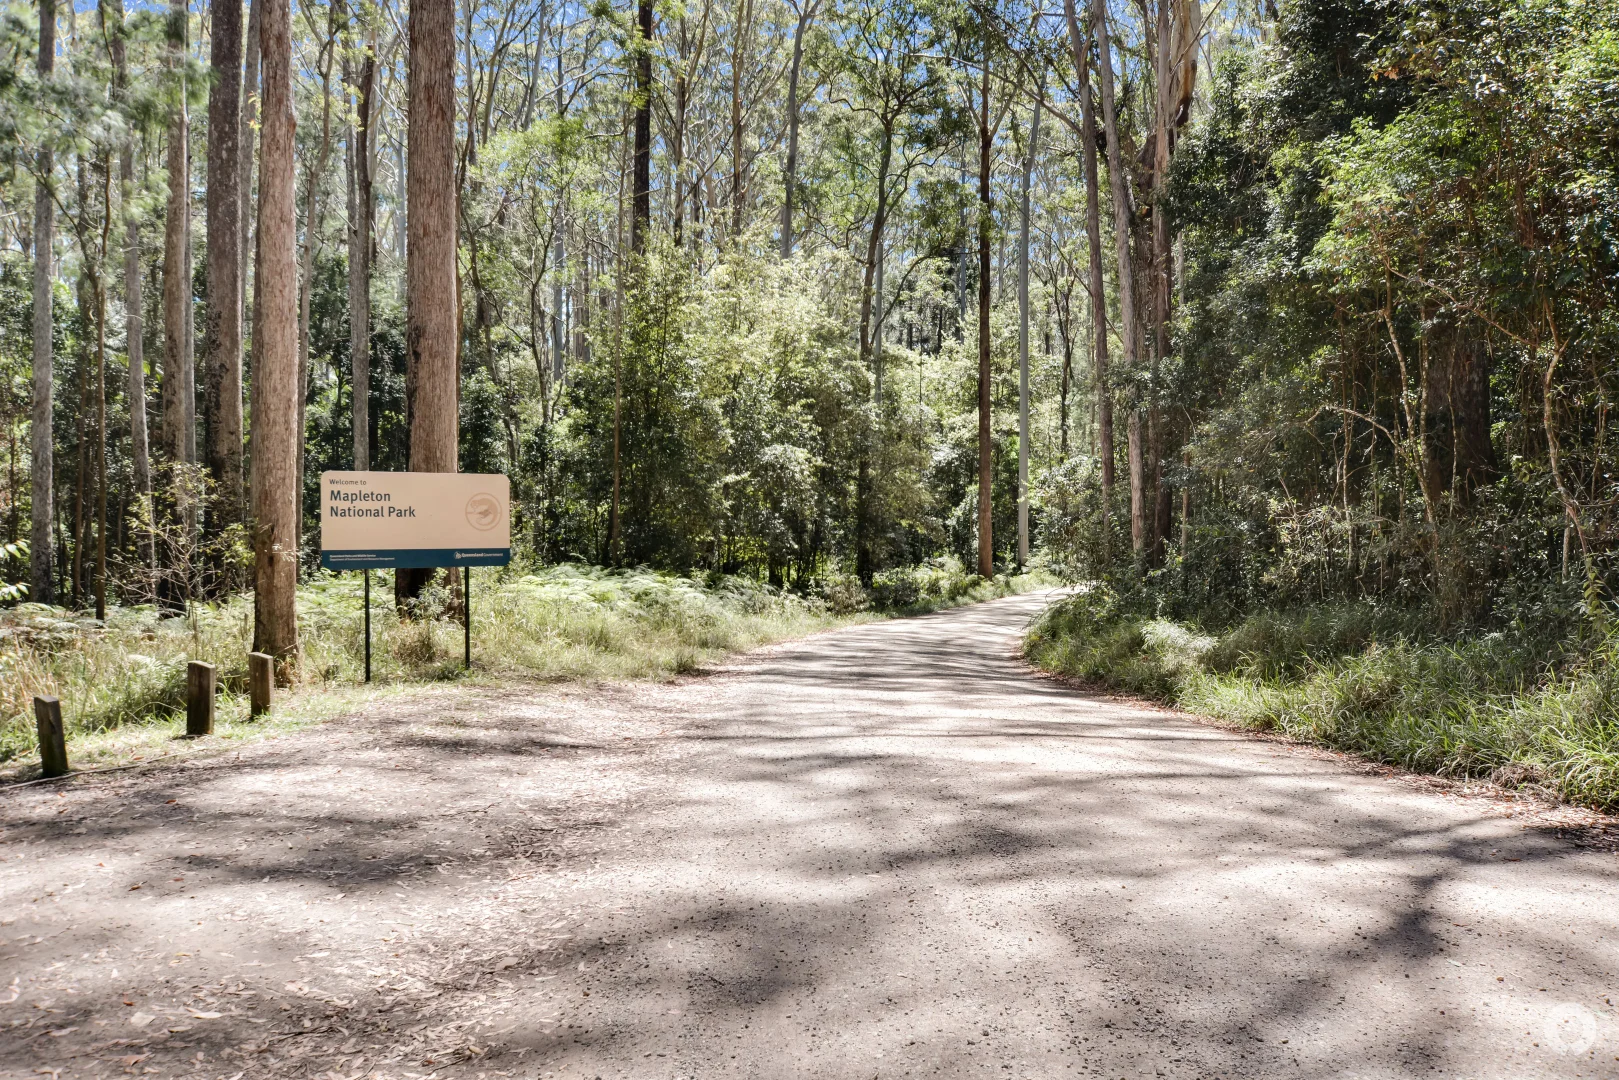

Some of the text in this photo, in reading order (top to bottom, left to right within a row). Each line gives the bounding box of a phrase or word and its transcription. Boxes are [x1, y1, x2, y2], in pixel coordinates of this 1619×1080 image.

[330, 490, 391, 504] Mapleton
[330, 506, 416, 517] National Park
